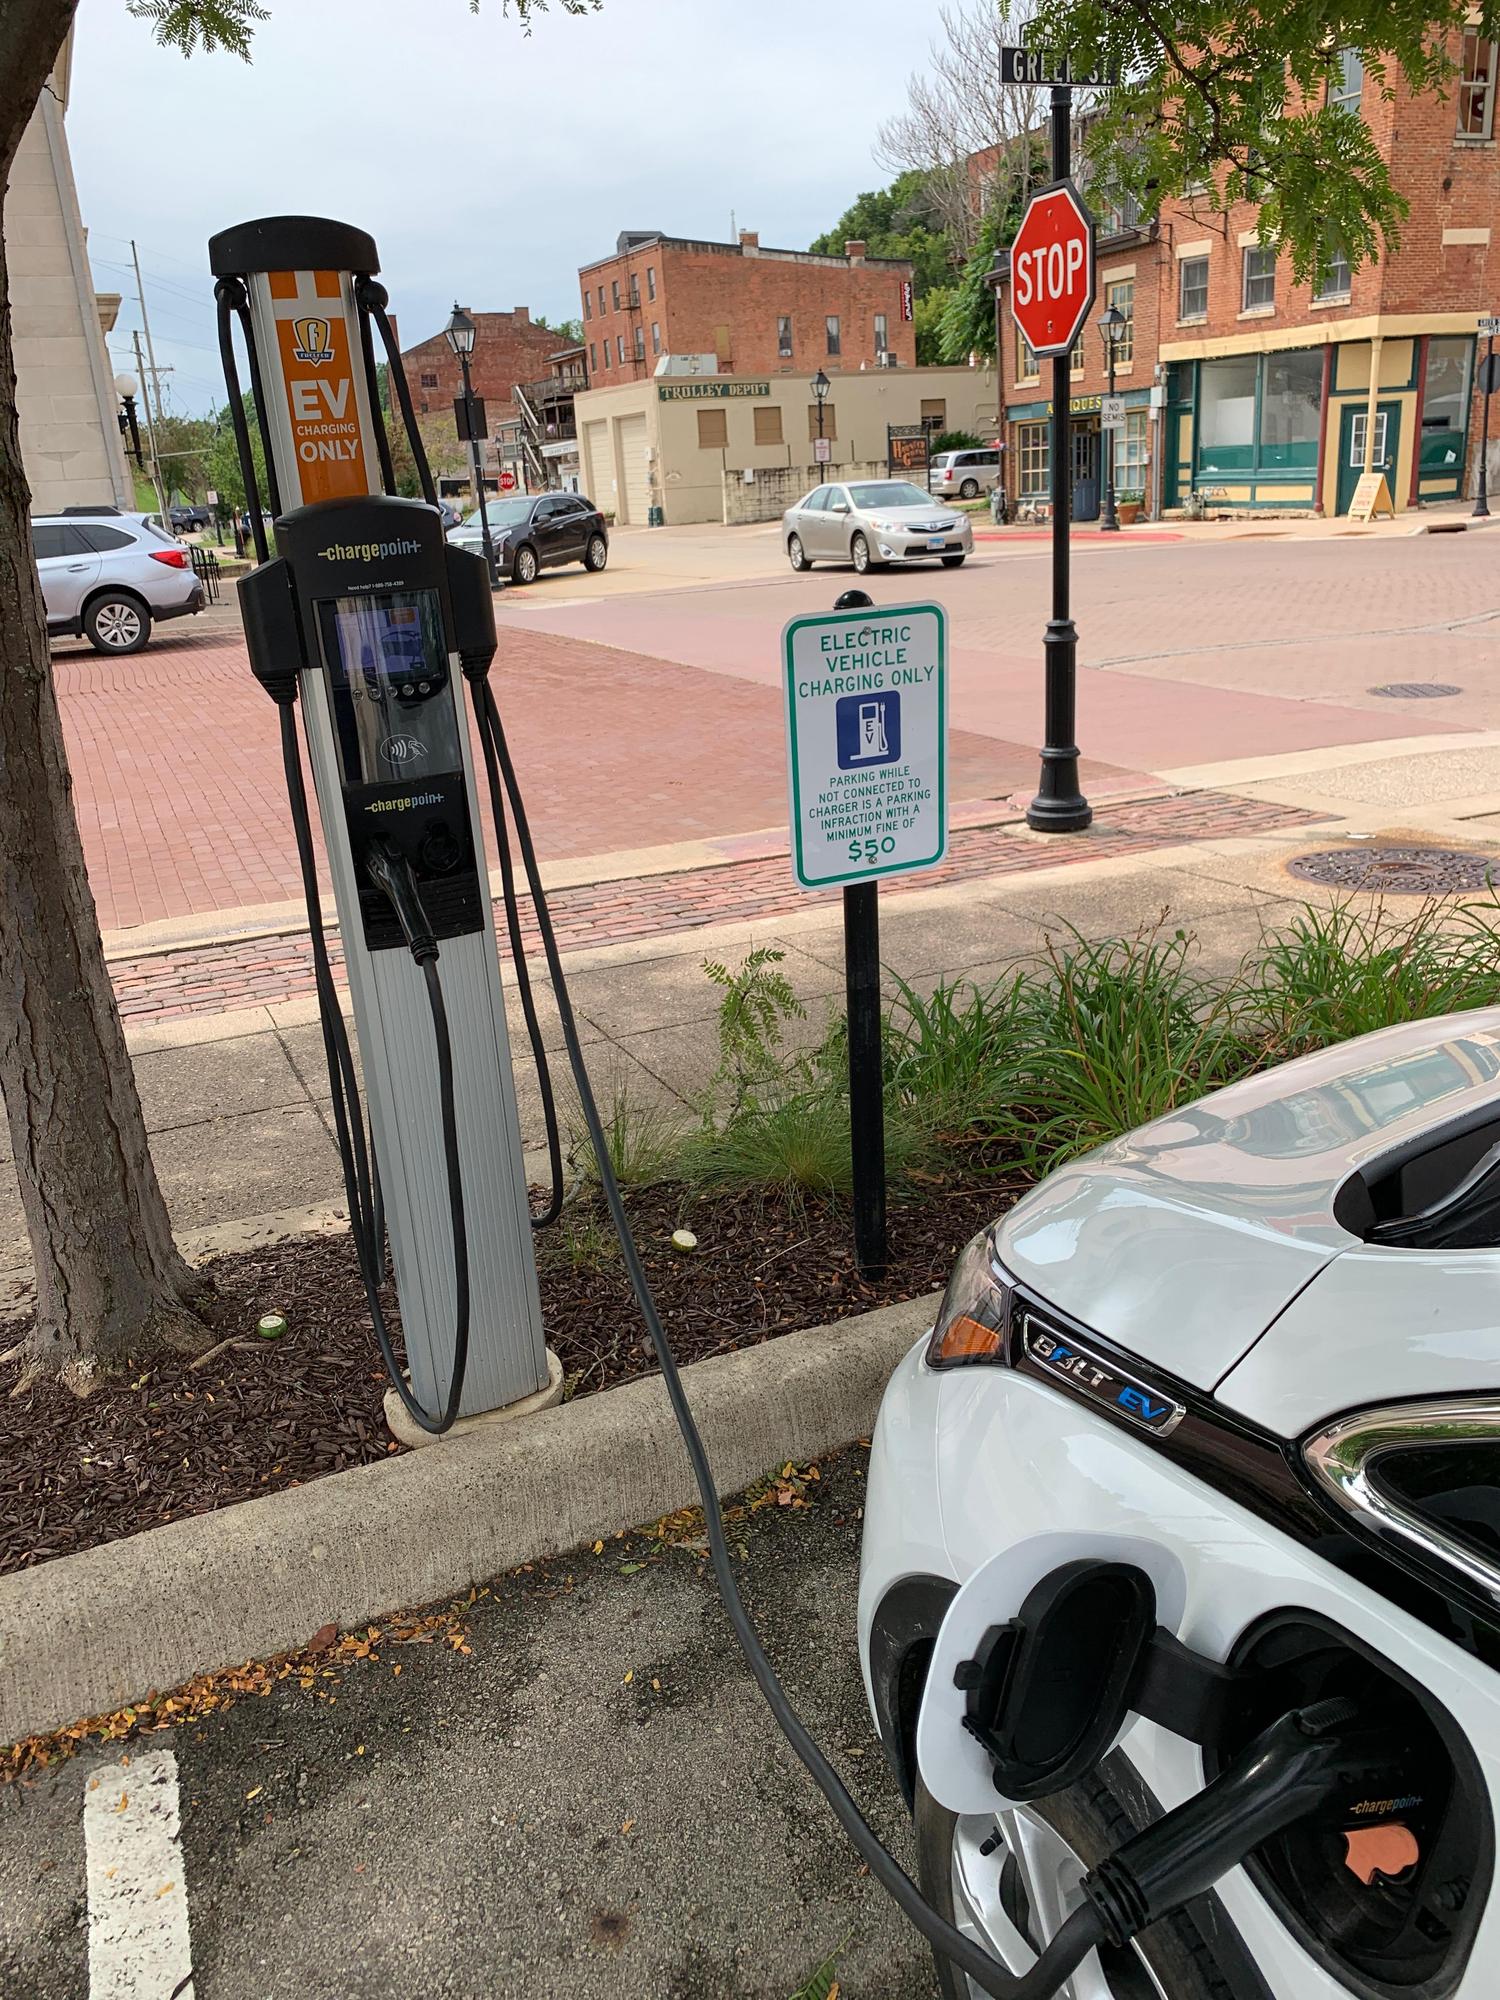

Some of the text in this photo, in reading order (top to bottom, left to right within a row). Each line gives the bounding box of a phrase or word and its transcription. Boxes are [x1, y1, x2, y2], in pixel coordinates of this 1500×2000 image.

[1016, 238, 1083, 306] STOP
[290, 378, 350, 421] EV
[661, 383, 768, 400] TROLLEY DEPOT
[1046, 396, 1102, 415] AIQUES
[1108, 403, 1120, 412] NO
[296, 423, 356, 436] CHARGING
[300, 438, 358, 463] ONLY
[499, 477, 514, 486] STOP
[820, 626, 911, 652] ELECTRIC
[826, 648, 907, 673] VEHICLE
[799, 665, 934, 698] CHARGING ONLY
[829, 765, 910, 788] PARKING WHILE
[809, 789, 931, 818] CHARGER IS A PARKING
[818, 778, 921, 804] NOT CONNECTED TO
[821, 804, 920, 830] INFRACTION WITH A
[826, 817, 915, 842] MINIMUM FINE OF
[848, 836, 896, 862] $50
[1032, 1333, 1168, 1420] BOLT EV
